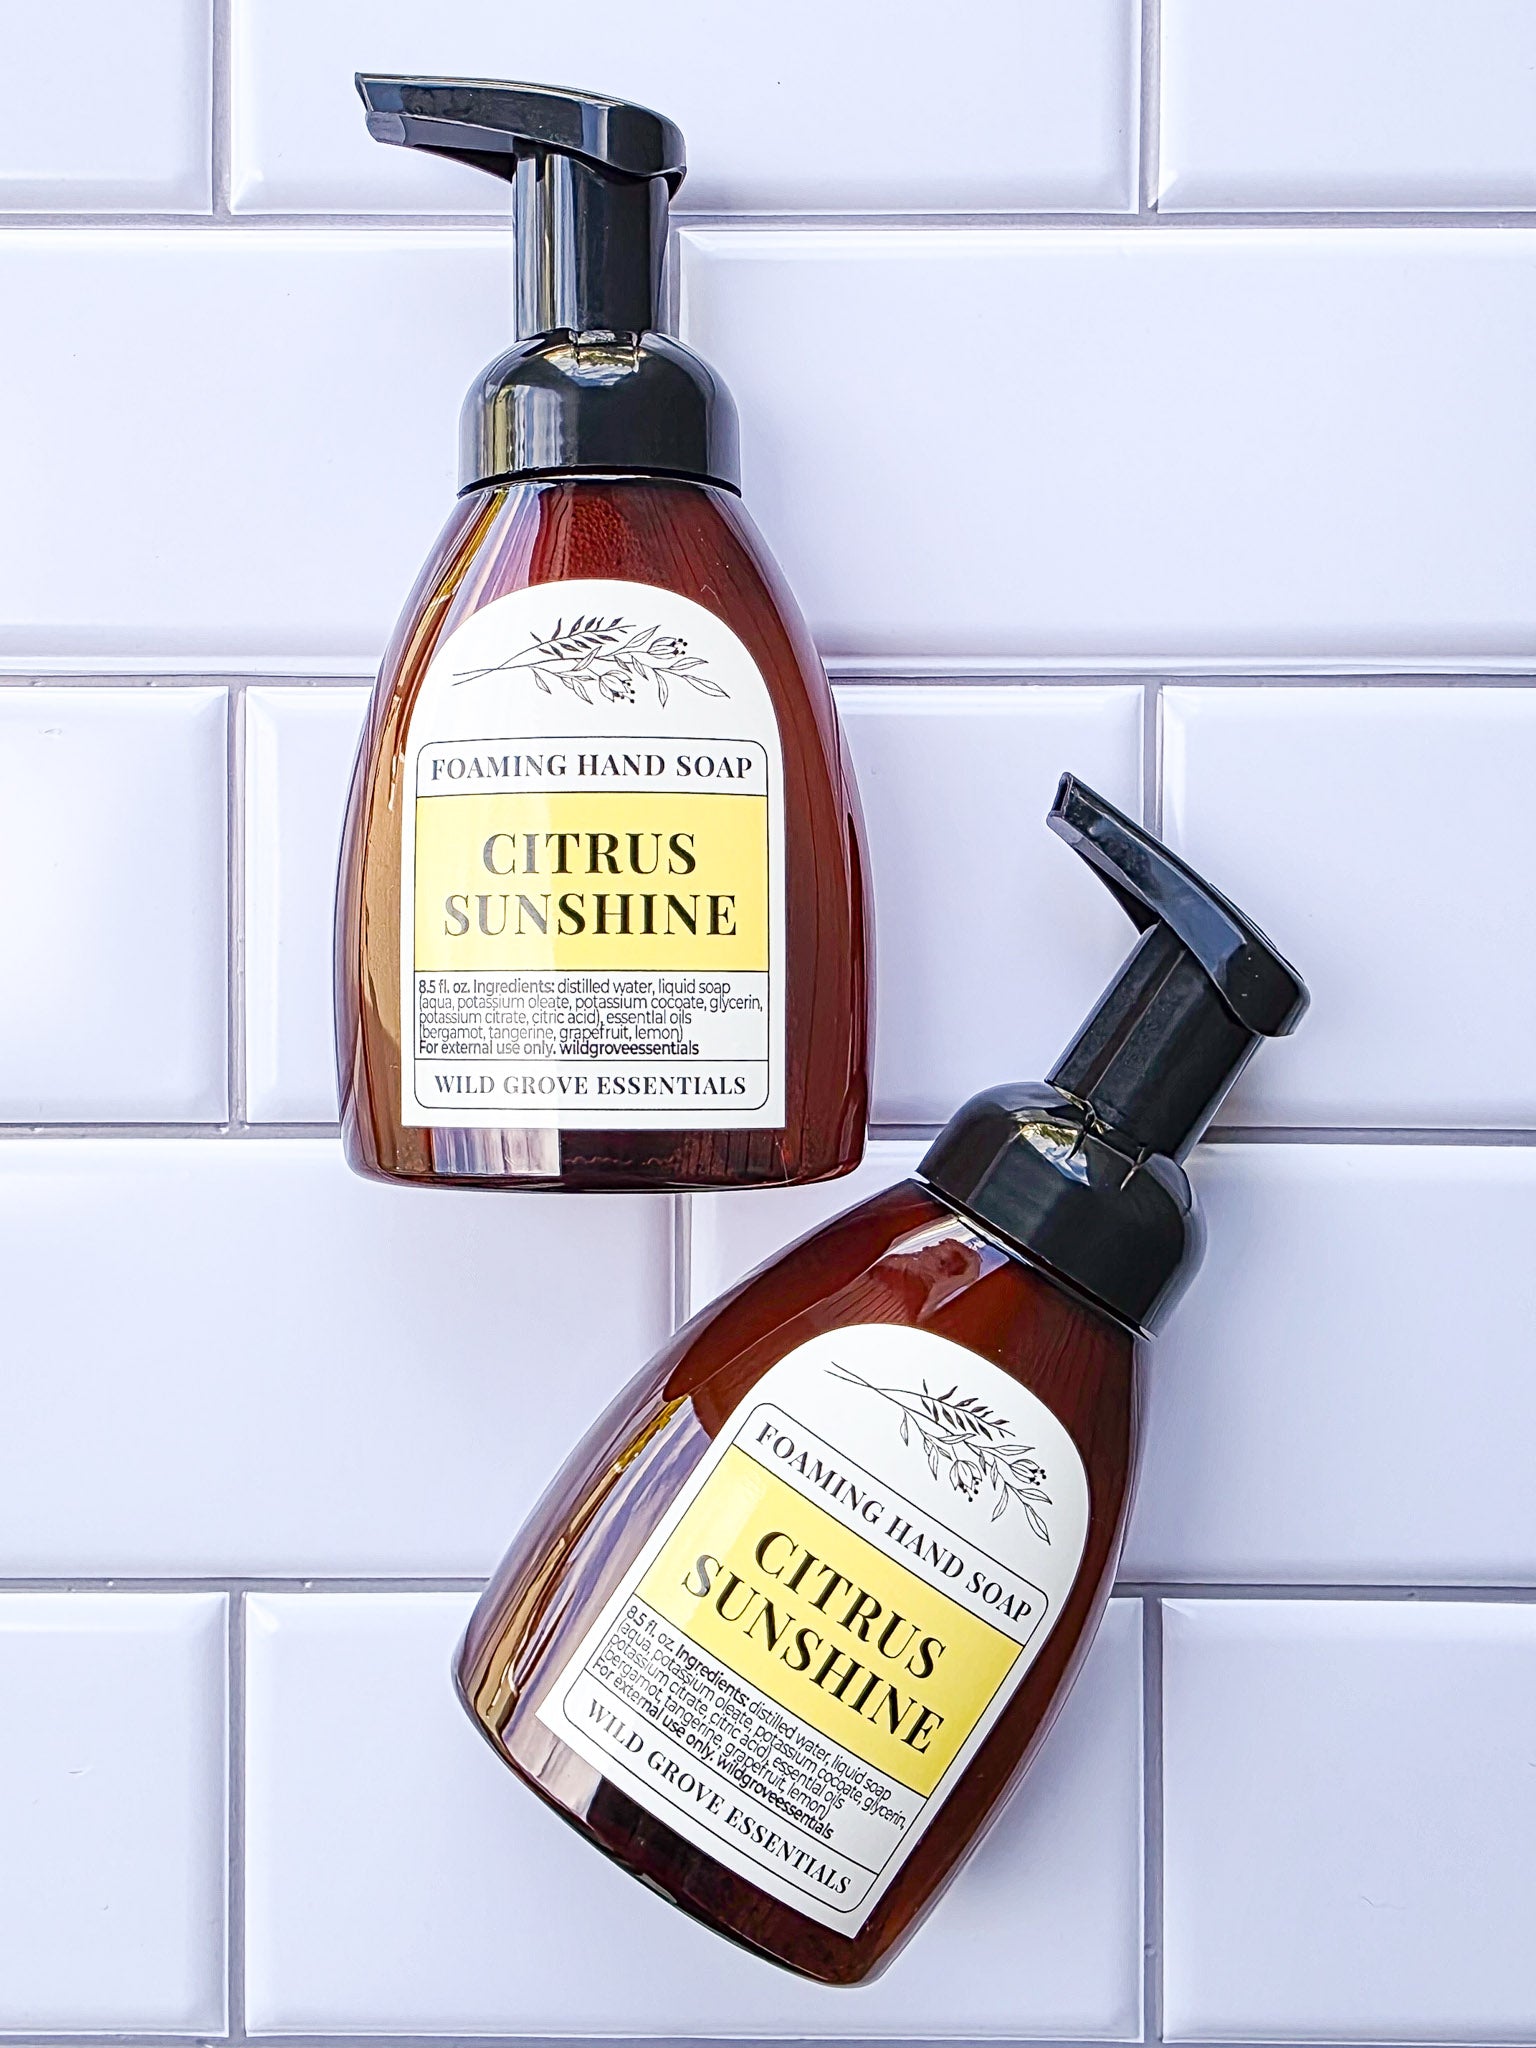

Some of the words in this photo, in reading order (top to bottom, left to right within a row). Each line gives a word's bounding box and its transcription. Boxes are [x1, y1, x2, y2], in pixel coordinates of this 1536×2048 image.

[431, 753, 567, 781] FOAMING
[577, 754, 666, 777] HAND
[675, 755, 752, 779] SOAP
[482, 832, 697, 875] CITRUS
[444, 893, 737, 936] SUNSHINE
[419, 994, 455, 1012] (aqua,
[457, 994, 525, 1012] potassium
[528, 995, 572, 1011] oleate,
[575, 993, 648, 1011] potassium
[651, 996, 707, 1012] cocoate,
[710, 994, 763, 1013] glycerin,
[419, 1009, 482, 1027] potassium
[485, 1009, 529, 1025] citrate,
[532, 1009, 565, 1024] citric
[567, 1008, 604, 1026] acid),
[606, 1010, 667, 1025] essential
[670, 1009, 692, 1025] oils
[419, 1024, 486, 1042] (bergamot,
[489, 1024, 556, 1042] tangerine,
[559, 1024, 632, 1042] grapefruit,
[635, 1025, 683, 1043] lemon)
[439, 979, 450, 993] fl.
[453, 981, 470, 993] oz.
[474, 978, 555, 996] Ingredients:
[557, 978, 610, 993] distilled
[613, 980, 655, 996] water,
[658, 978, 696, 997] liquid
[699, 982, 731, 997] soap
[419, 1040, 438, 1054] For
[441, 1040, 493, 1055] external
[496, 1042, 520, 1055] use
[523, 1040, 556, 1058] only.
[559, 1040, 700, 1058] wildgroveessentials
[434, 1074, 495, 1094] WILD
[503, 1075, 588, 1095] GROVE
[597, 1075, 746, 1095] ESSENTIALS
[755, 1421, 885, 1524] FOAMING
[885, 1515, 964, 1578] HAND
[965, 1571, 1032, 1623] SOAP
[755, 1531, 947, 1679] CITRUS
[681, 1554, 945, 1754] SUNSHINE
[592, 1656, 615, 1680] For
[613, 1677, 664, 1721] external
[662, 1713, 686, 1738] use
[685, 1732, 715, 1762] only.
[716, 1756, 835, 1839] wildgroveessentials
[600, 1643, 663, 1704] (bergamot,
[664, 1695, 723, 1750] tangerine,
[724, 1742, 786, 1794] grapefruit,
[786, 1782, 832, 1821] lemon)
[608, 1634, 669, 1686] potassium
[669, 1681, 708, 1719] citrate,
[710, 1713, 741, 1739] citric
[739, 1733, 772, 1766] acid),
[772, 1756, 826, 1796] essential
[824, 1790, 846, 1809] oils
[617, 1617, 651, 1654] (aqua,
[650, 1649, 715, 1701] potassium
[715, 1697, 752, 1732] oleate,
[753, 1725, 817, 1774] potassium
[817, 1768, 863, 1805] cocoate,
[861, 1797, 906, 1830] glycerin,
[644, 1619, 658, 1638] fl.
[657, 1633, 675, 1652] oz.
[675, 1644, 750, 1707] Ingredients:
[748, 1700, 798, 1740] distilled
[796, 1732, 831, 1766] water,
[830, 1754, 866, 1784] liquid
[863, 1777, 892, 1801] soap
[587, 1698, 644, 1753] WILD
[647, 1750, 726, 1816] GROVE
[725, 1806, 852, 1894] ESSENTIALS
